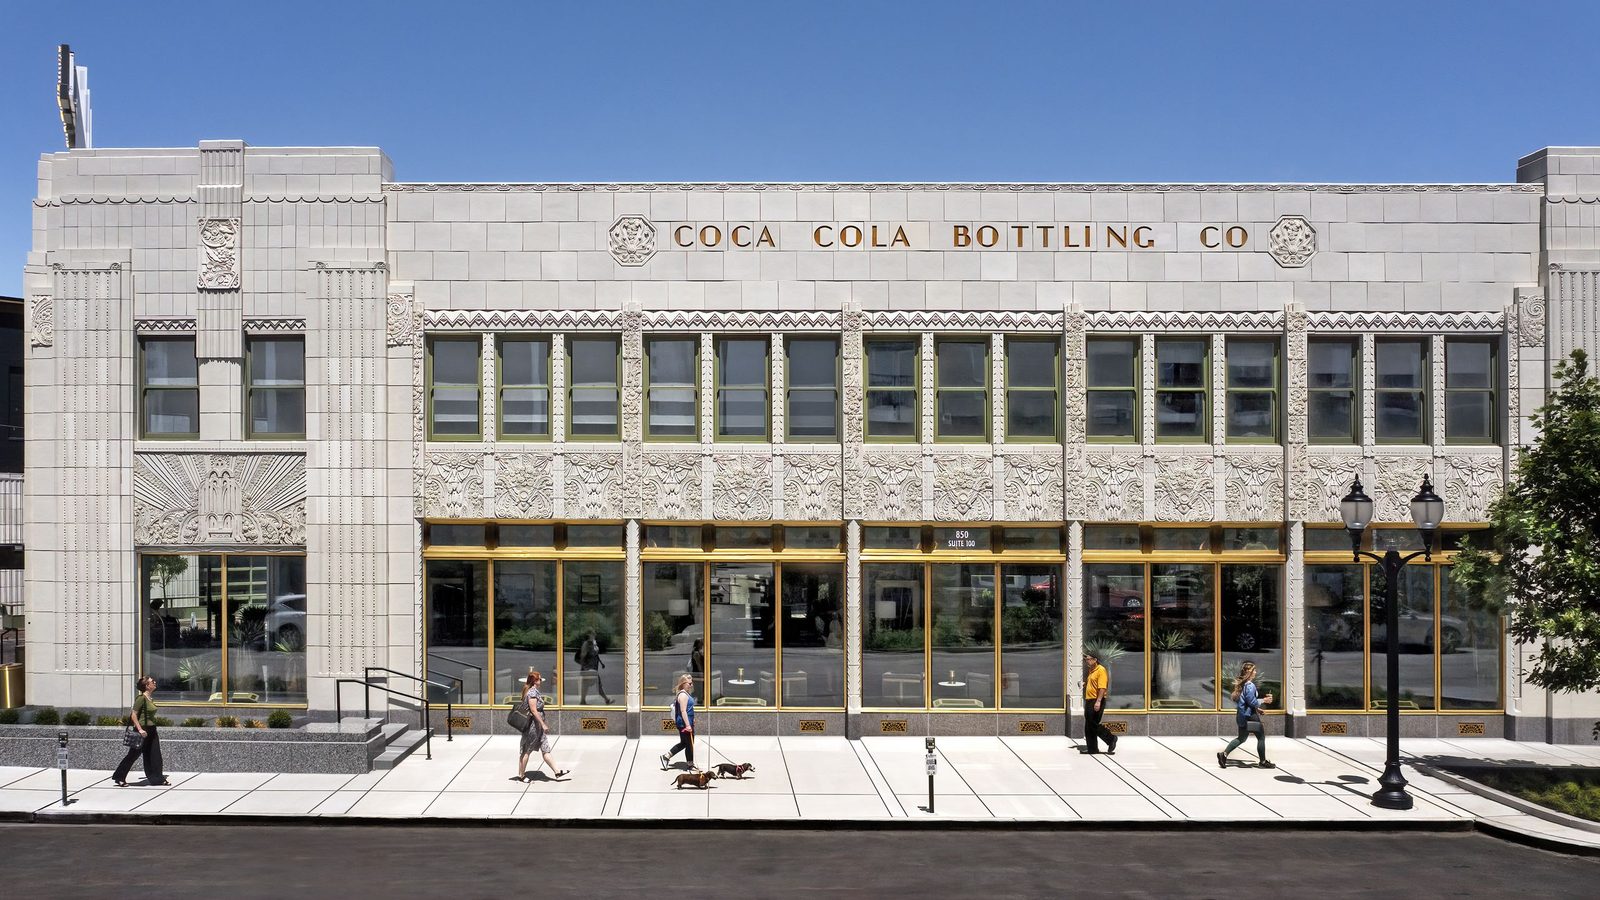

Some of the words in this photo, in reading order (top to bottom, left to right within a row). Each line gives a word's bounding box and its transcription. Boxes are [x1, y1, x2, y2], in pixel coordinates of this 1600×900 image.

[674, 225, 776, 248] COCA
[813, 225, 911, 248] COLA
[953, 225, 1155, 248] BOTTLING
[1199, 225, 1249, 249] CO
[955, 530, 969, 539] 850
